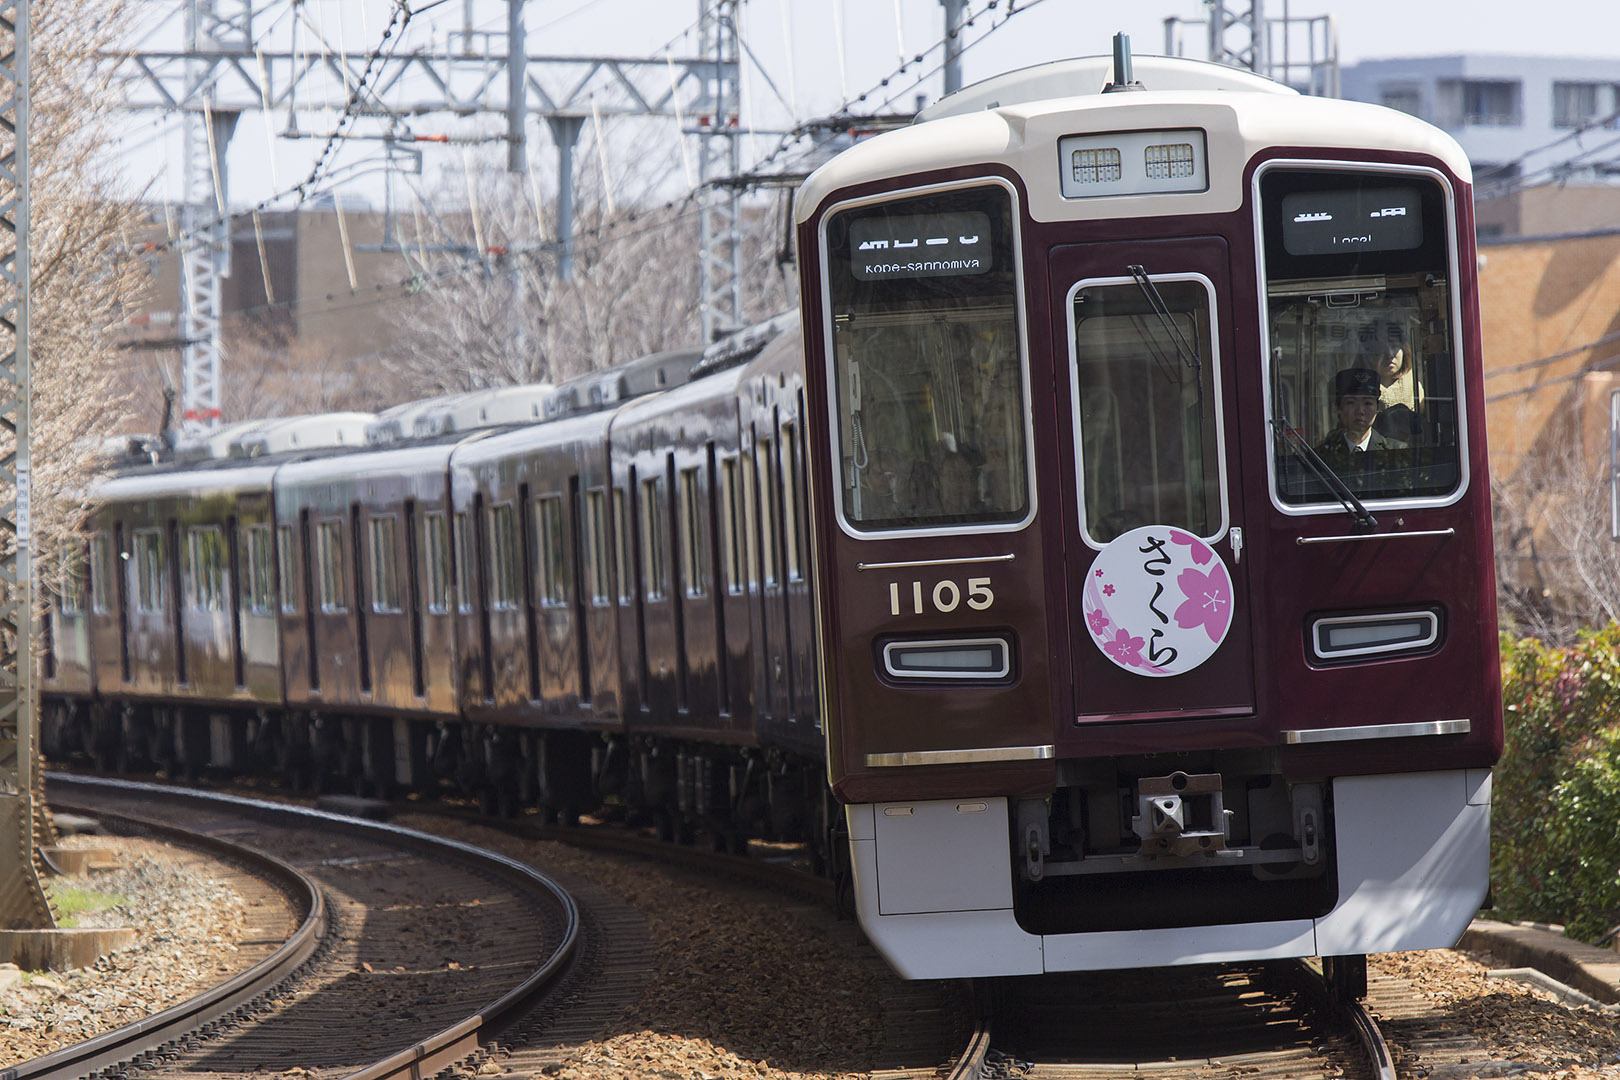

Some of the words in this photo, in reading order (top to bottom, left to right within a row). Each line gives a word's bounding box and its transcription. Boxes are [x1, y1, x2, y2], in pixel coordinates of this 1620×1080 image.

[889, 577, 995, 616] 1105
[1139, 536, 1178, 668] さくら
